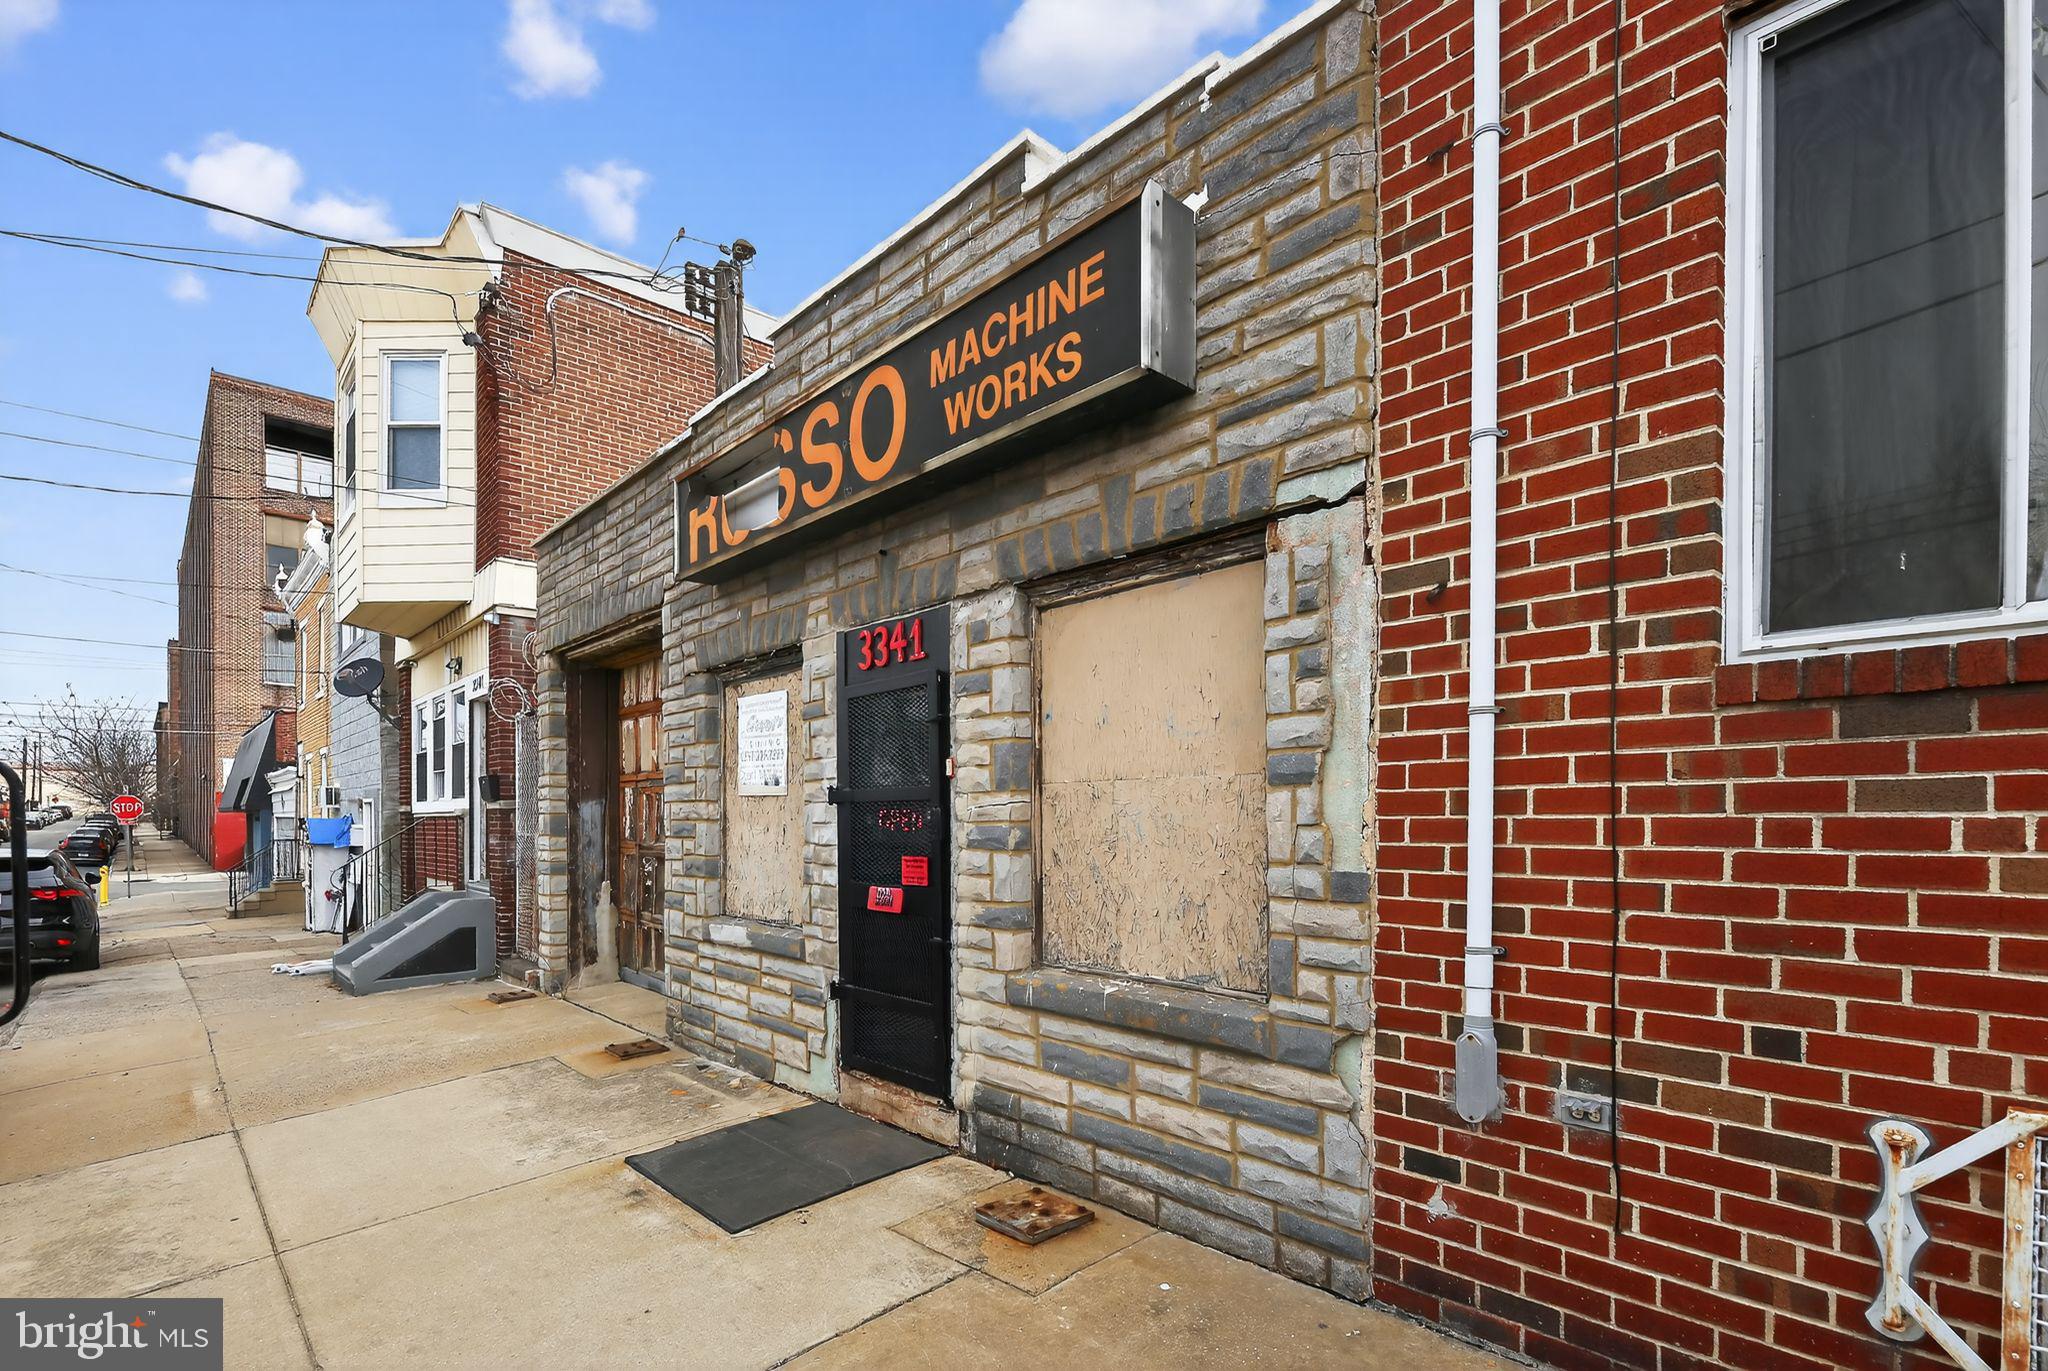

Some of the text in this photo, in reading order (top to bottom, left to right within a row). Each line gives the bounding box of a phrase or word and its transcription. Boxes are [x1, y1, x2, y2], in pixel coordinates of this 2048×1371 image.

[930, 249, 1106, 388] MACHINE
[943, 331, 1083, 436] WORKS
[857, 618, 926, 671] 3341
[112, 802, 142, 813] STOP
